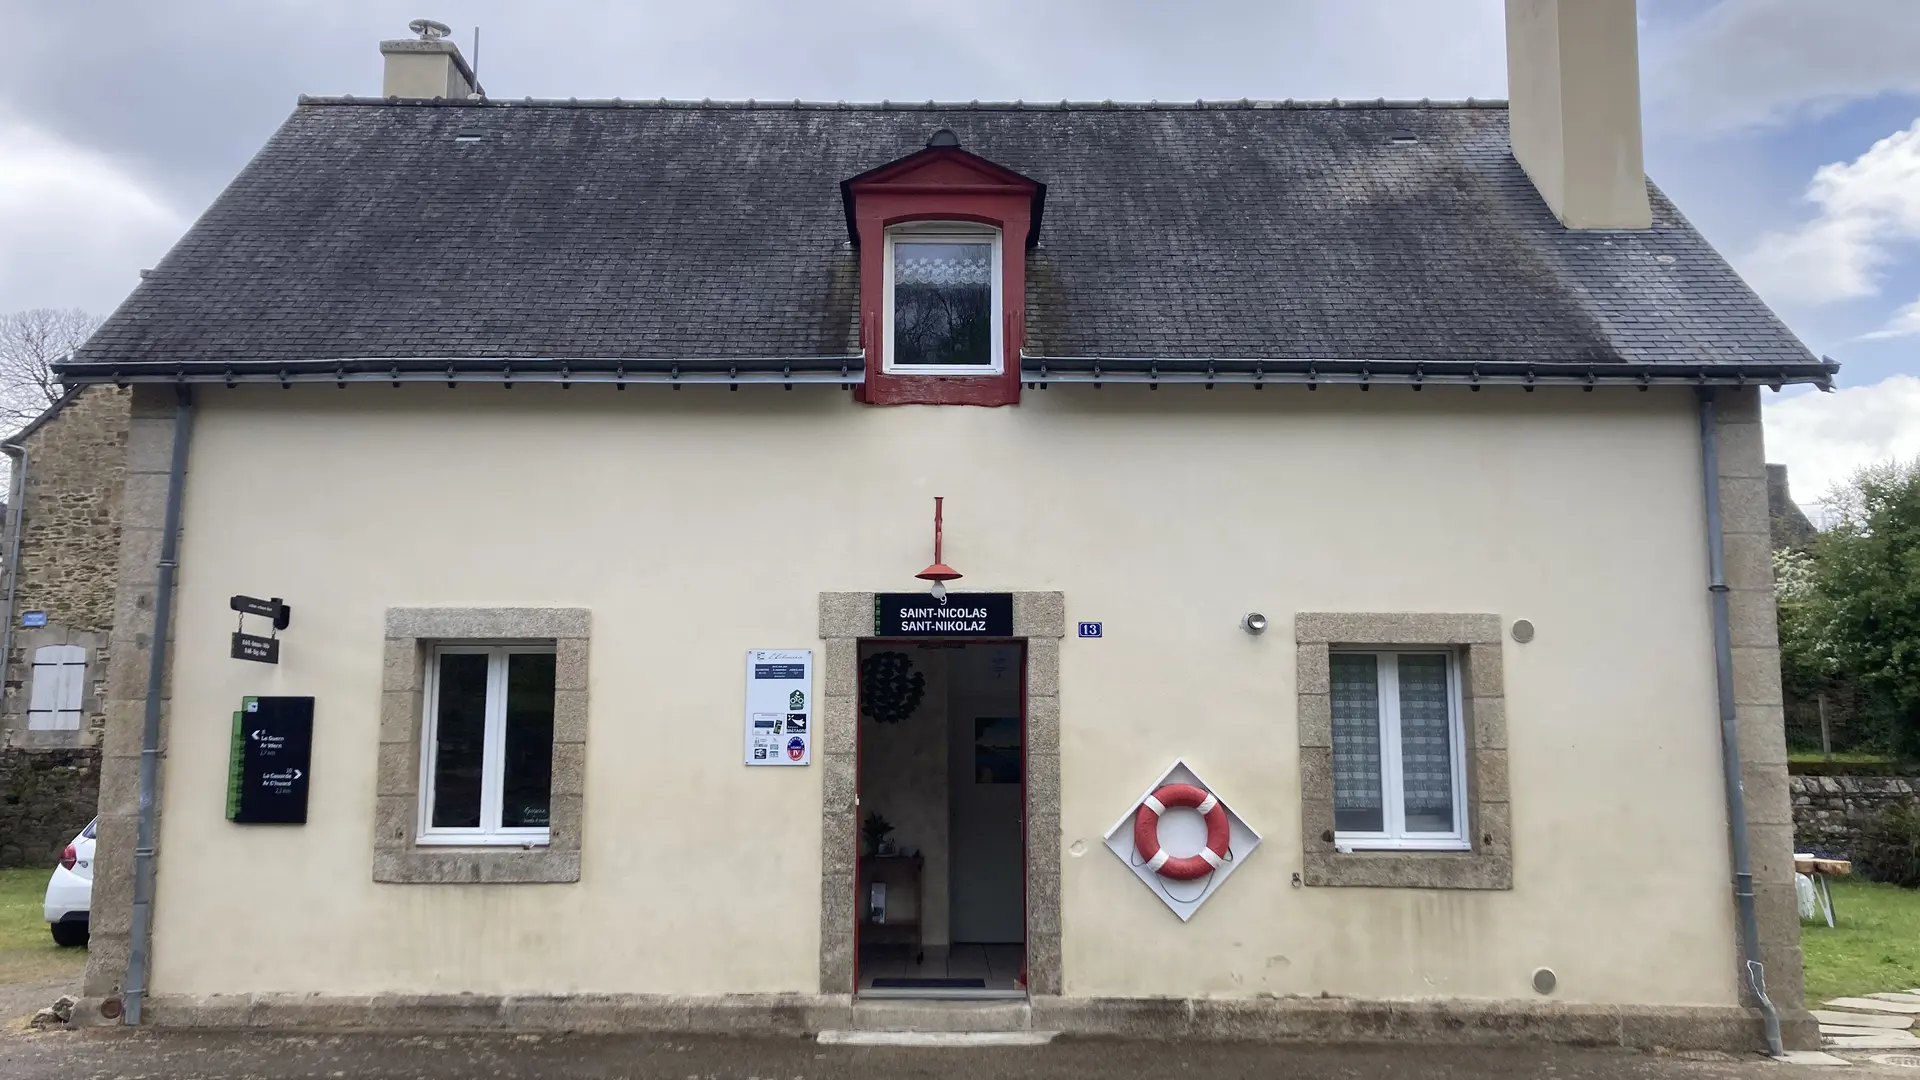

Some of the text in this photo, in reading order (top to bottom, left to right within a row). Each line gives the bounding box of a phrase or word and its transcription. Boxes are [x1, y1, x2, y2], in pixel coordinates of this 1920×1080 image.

[940, 595, 947, 606] 9
[900, 608, 987, 618] SAINT-NICOLAS
[901, 621, 986, 631] SANT-NIKOLAZ
[1084, 624, 1097, 634] 13
